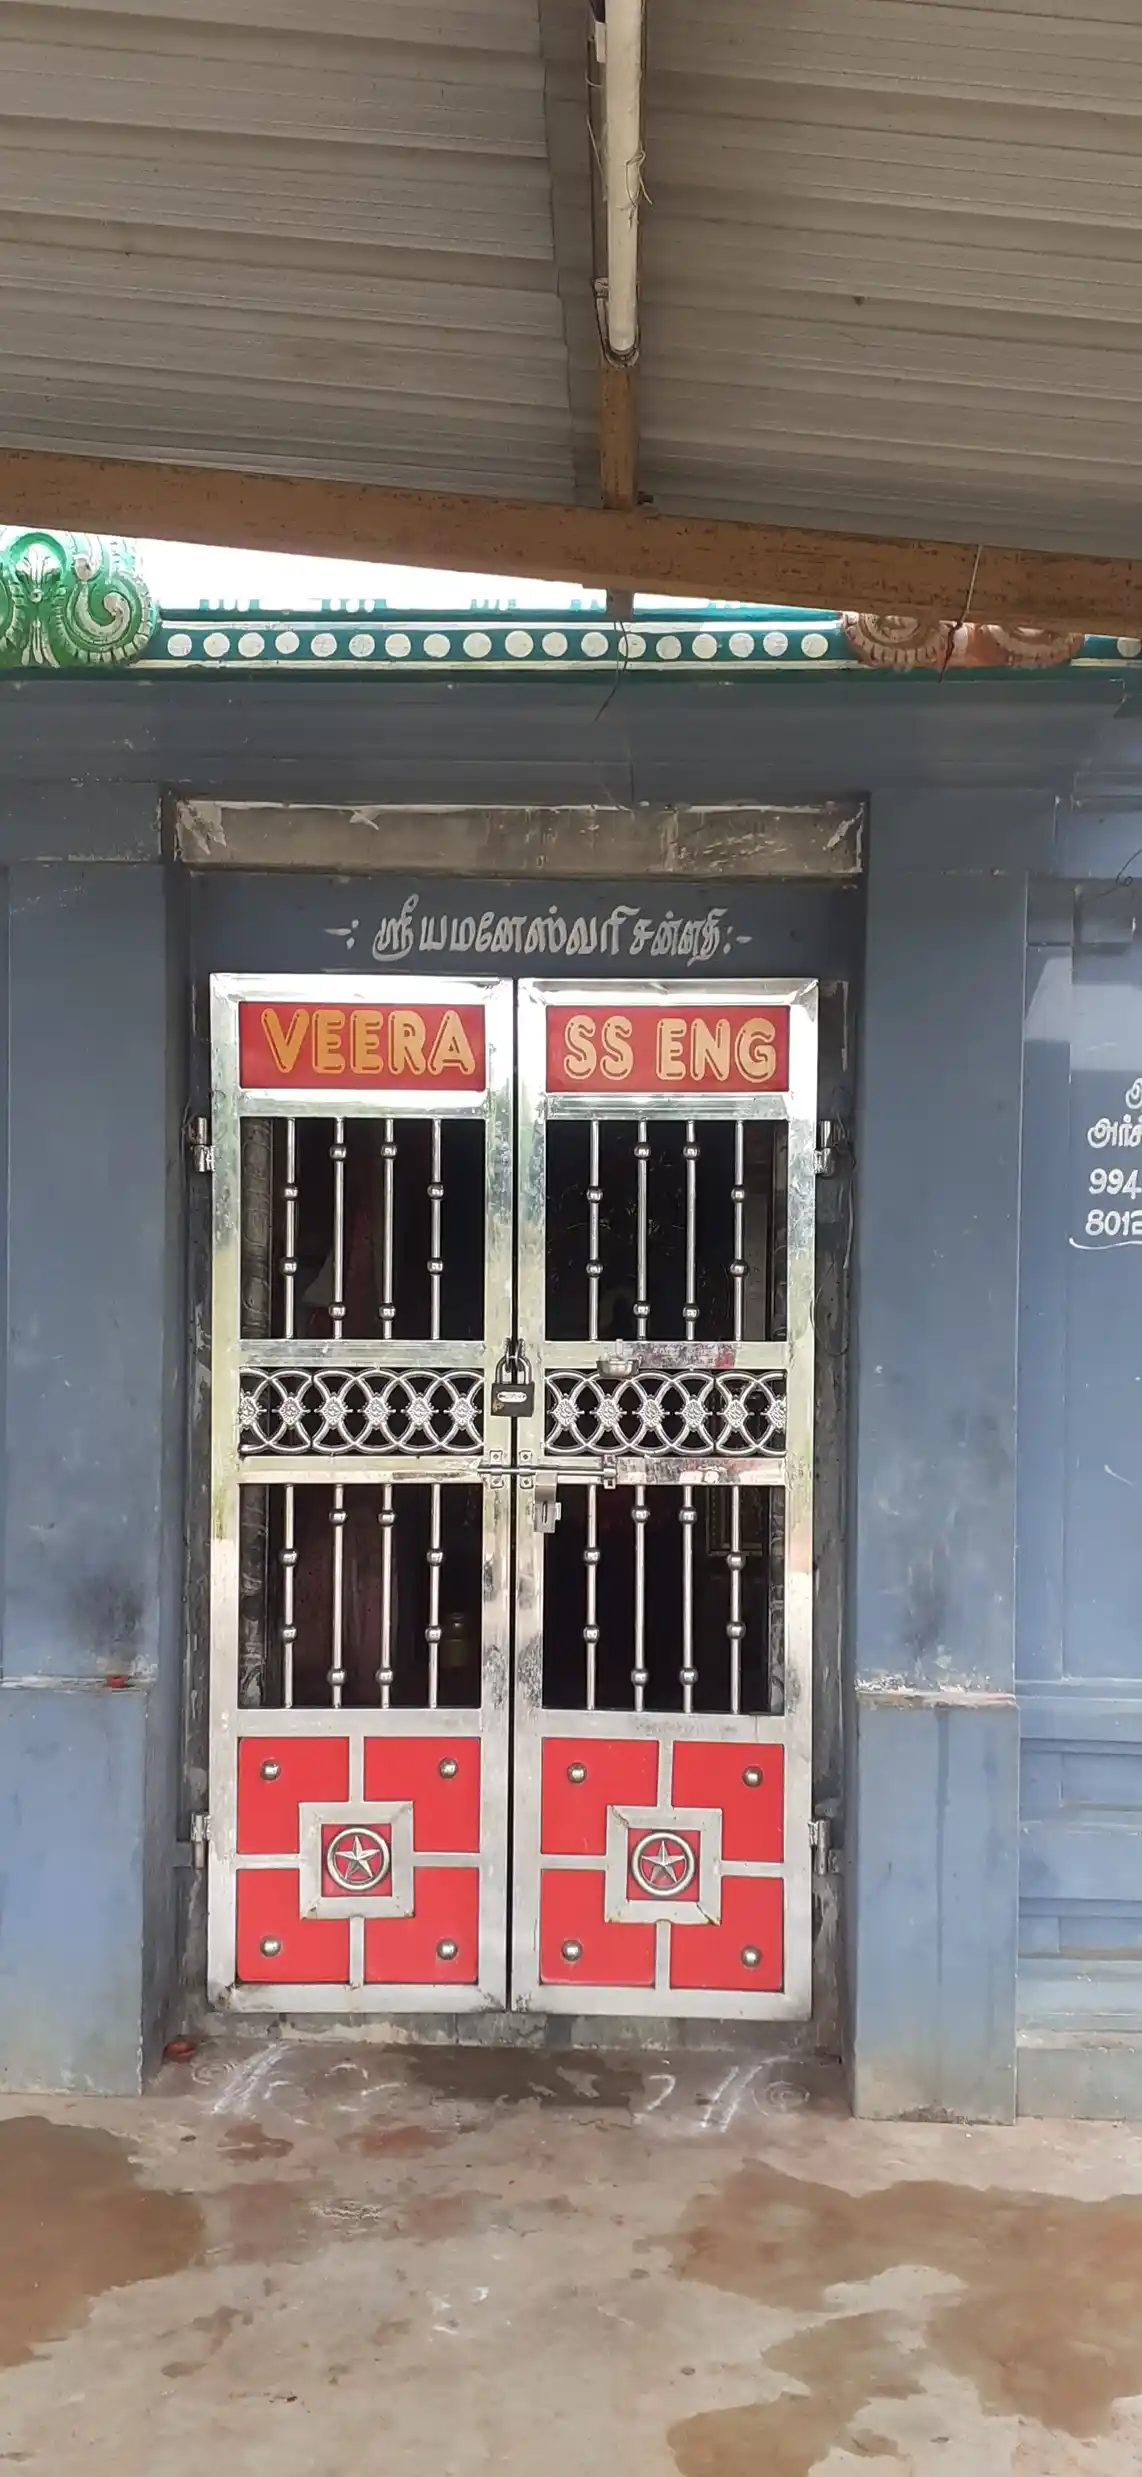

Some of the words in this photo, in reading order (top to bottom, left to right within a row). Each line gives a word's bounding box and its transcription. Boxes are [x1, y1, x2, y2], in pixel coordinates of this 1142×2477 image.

[261, 1008, 476, 1075] VEERA
[564, 1015, 634, 1080] SS
[656, 1017, 776, 1083] ENG
